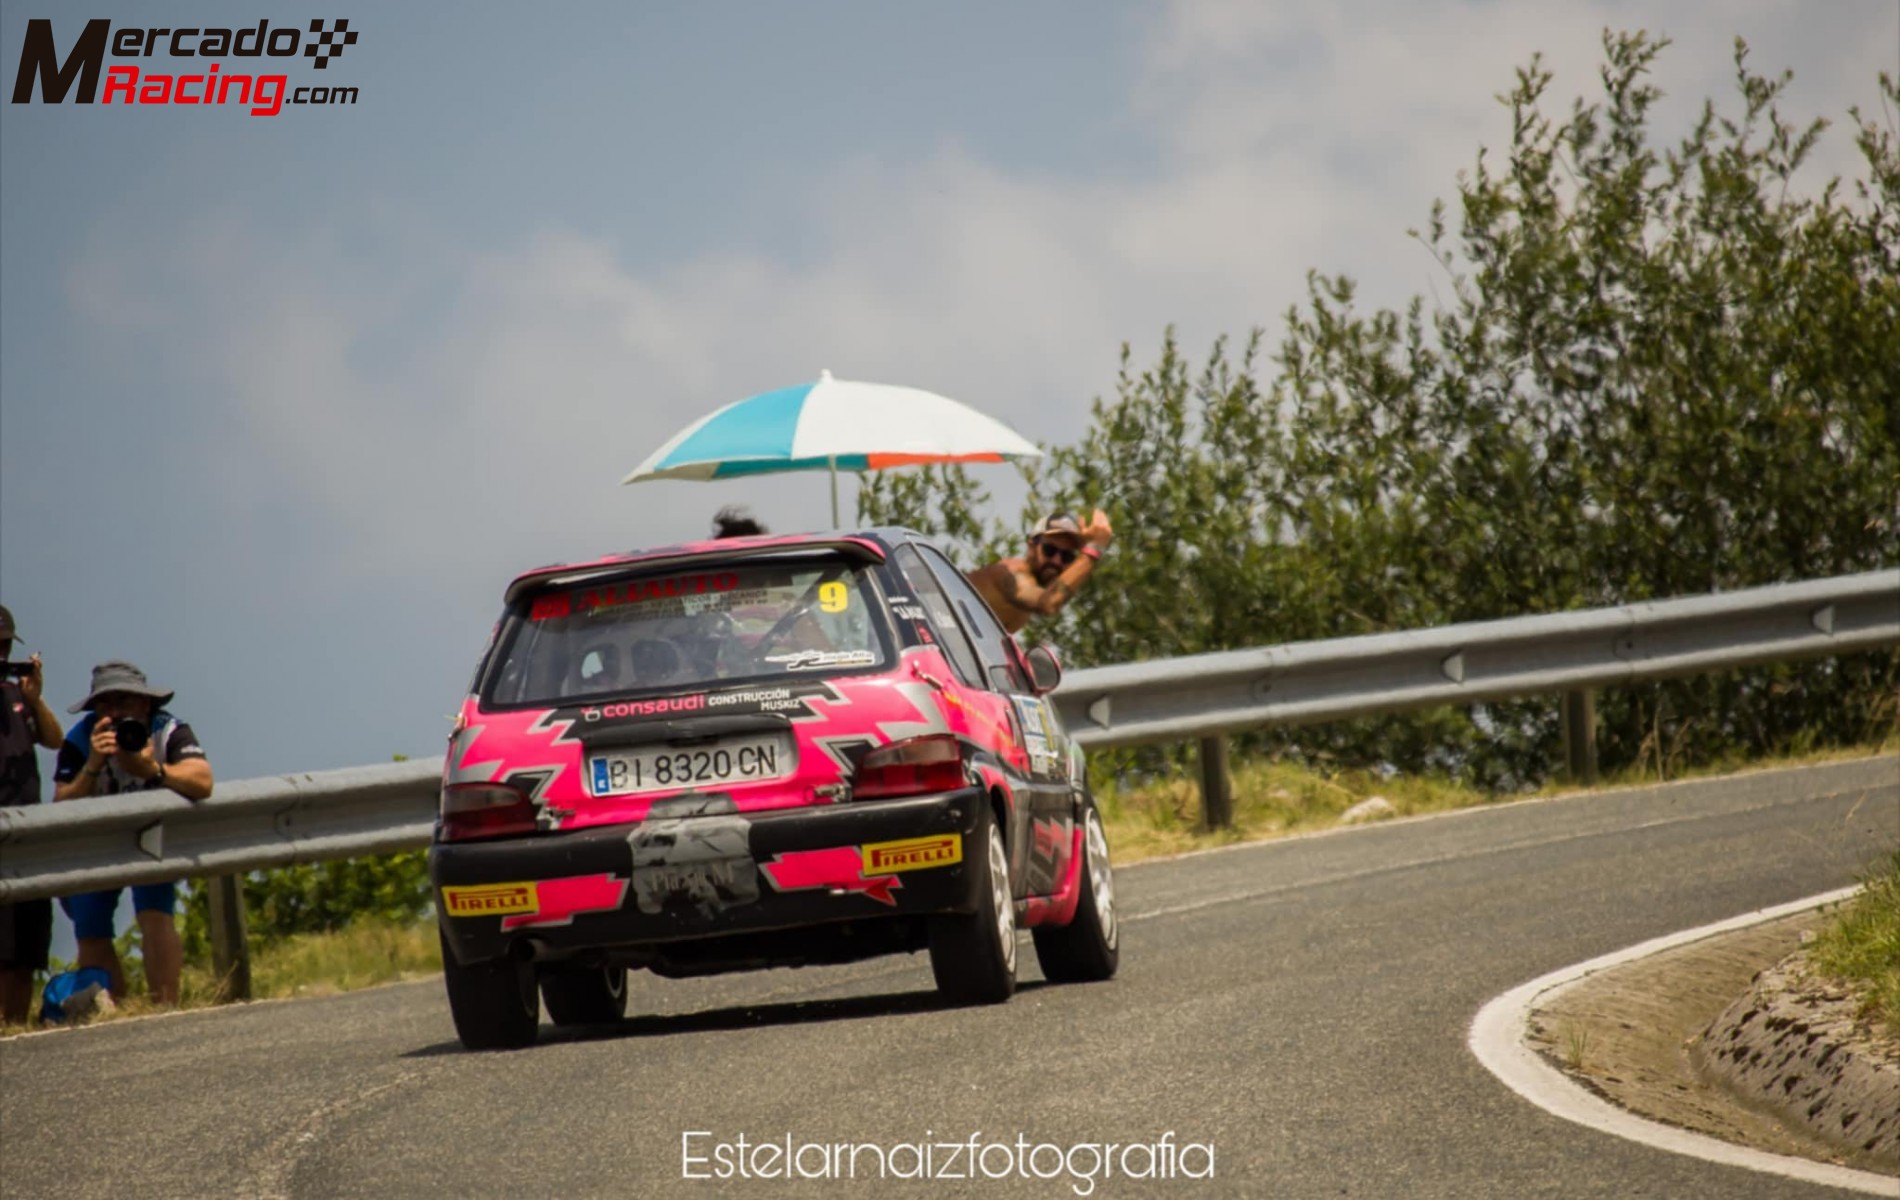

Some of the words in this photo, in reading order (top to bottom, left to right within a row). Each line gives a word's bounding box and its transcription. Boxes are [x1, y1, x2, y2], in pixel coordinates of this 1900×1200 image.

[819, 581, 847, 613] 9
[602, 694, 705, 718] consaudi
[708, 688, 791, 706] CONSTRUCCIÓN
[760, 699, 800, 711] MUSKIZ
[609, 759, 641, 788] BI
[654, 749, 732, 784] 8320
[738, 745, 777, 776] CN
[870, 840, 954, 868] PIRELLI
[449, 888, 529, 911] PIRELLI
